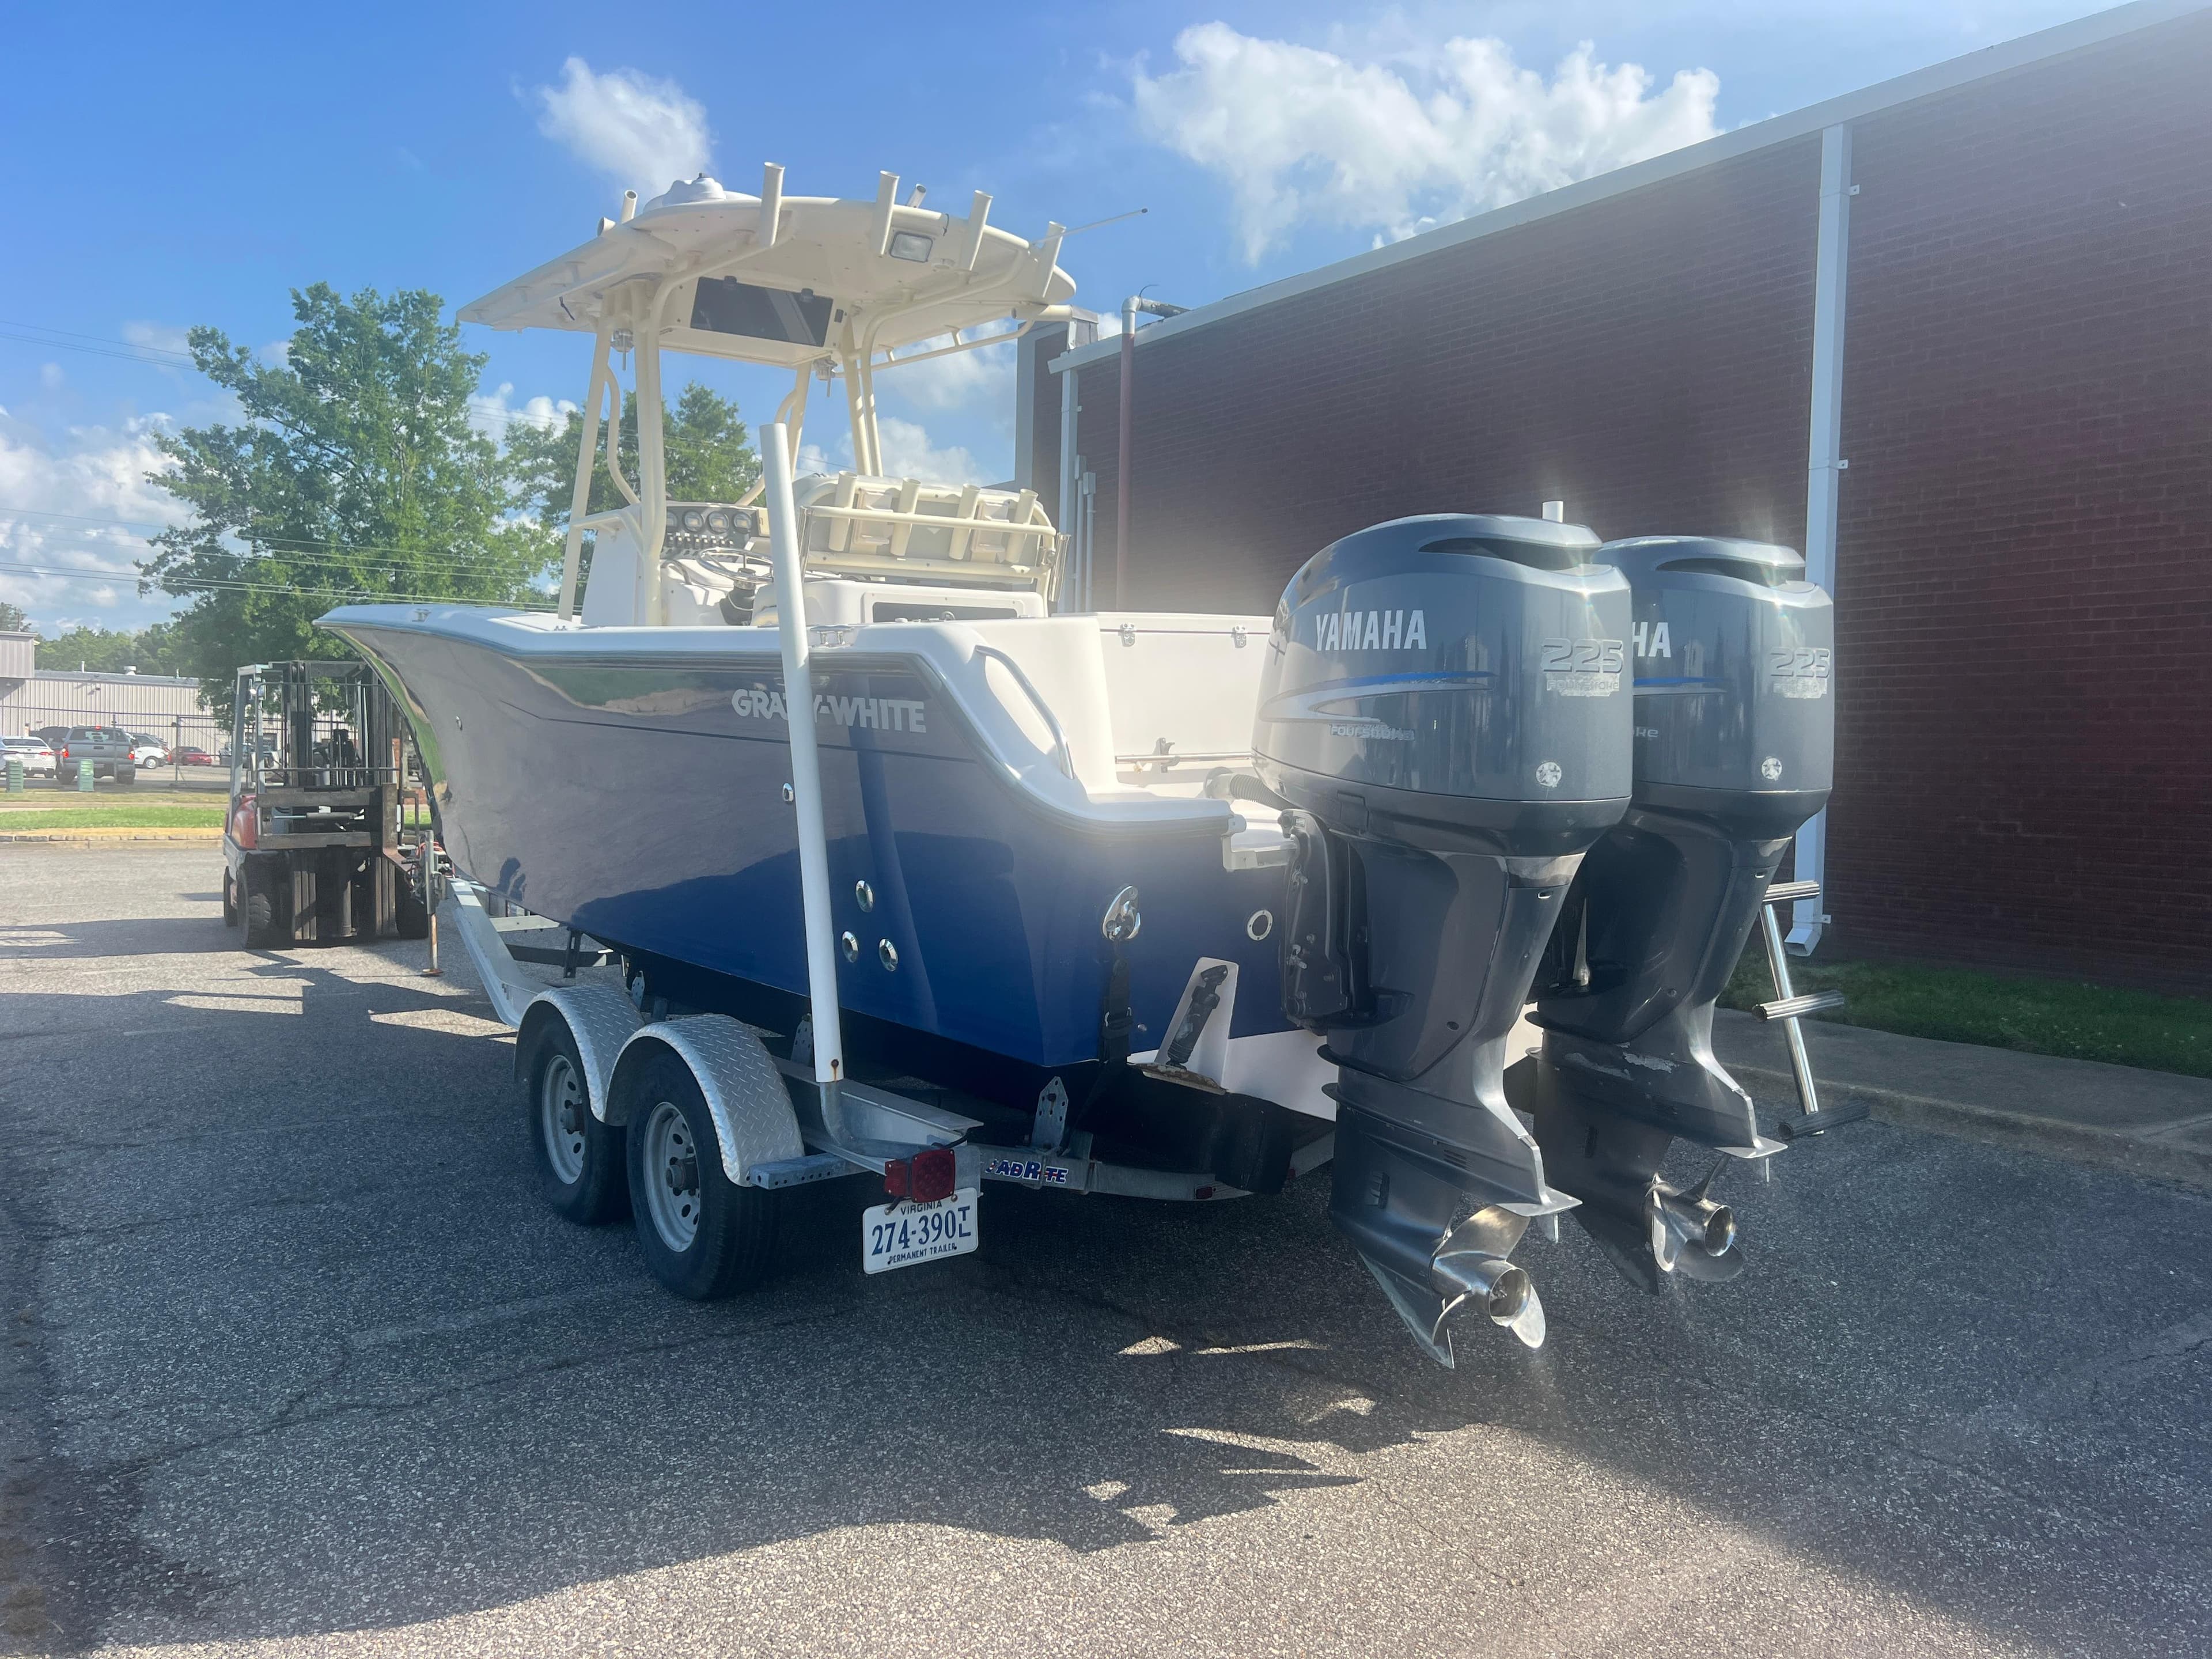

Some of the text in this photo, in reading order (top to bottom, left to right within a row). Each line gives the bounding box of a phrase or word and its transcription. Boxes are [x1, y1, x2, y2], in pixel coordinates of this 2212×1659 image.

[1316, 609, 1427, 651] YAMAHA
[1540, 638, 1623, 673] 225
[1770, 646, 1830, 678] 225
[732, 689, 926, 733] GRAY-WHITE
[900, 1200, 942, 1215] VIRGINIA
[889, 1243, 956, 1263] PERMANENT TRAILER
